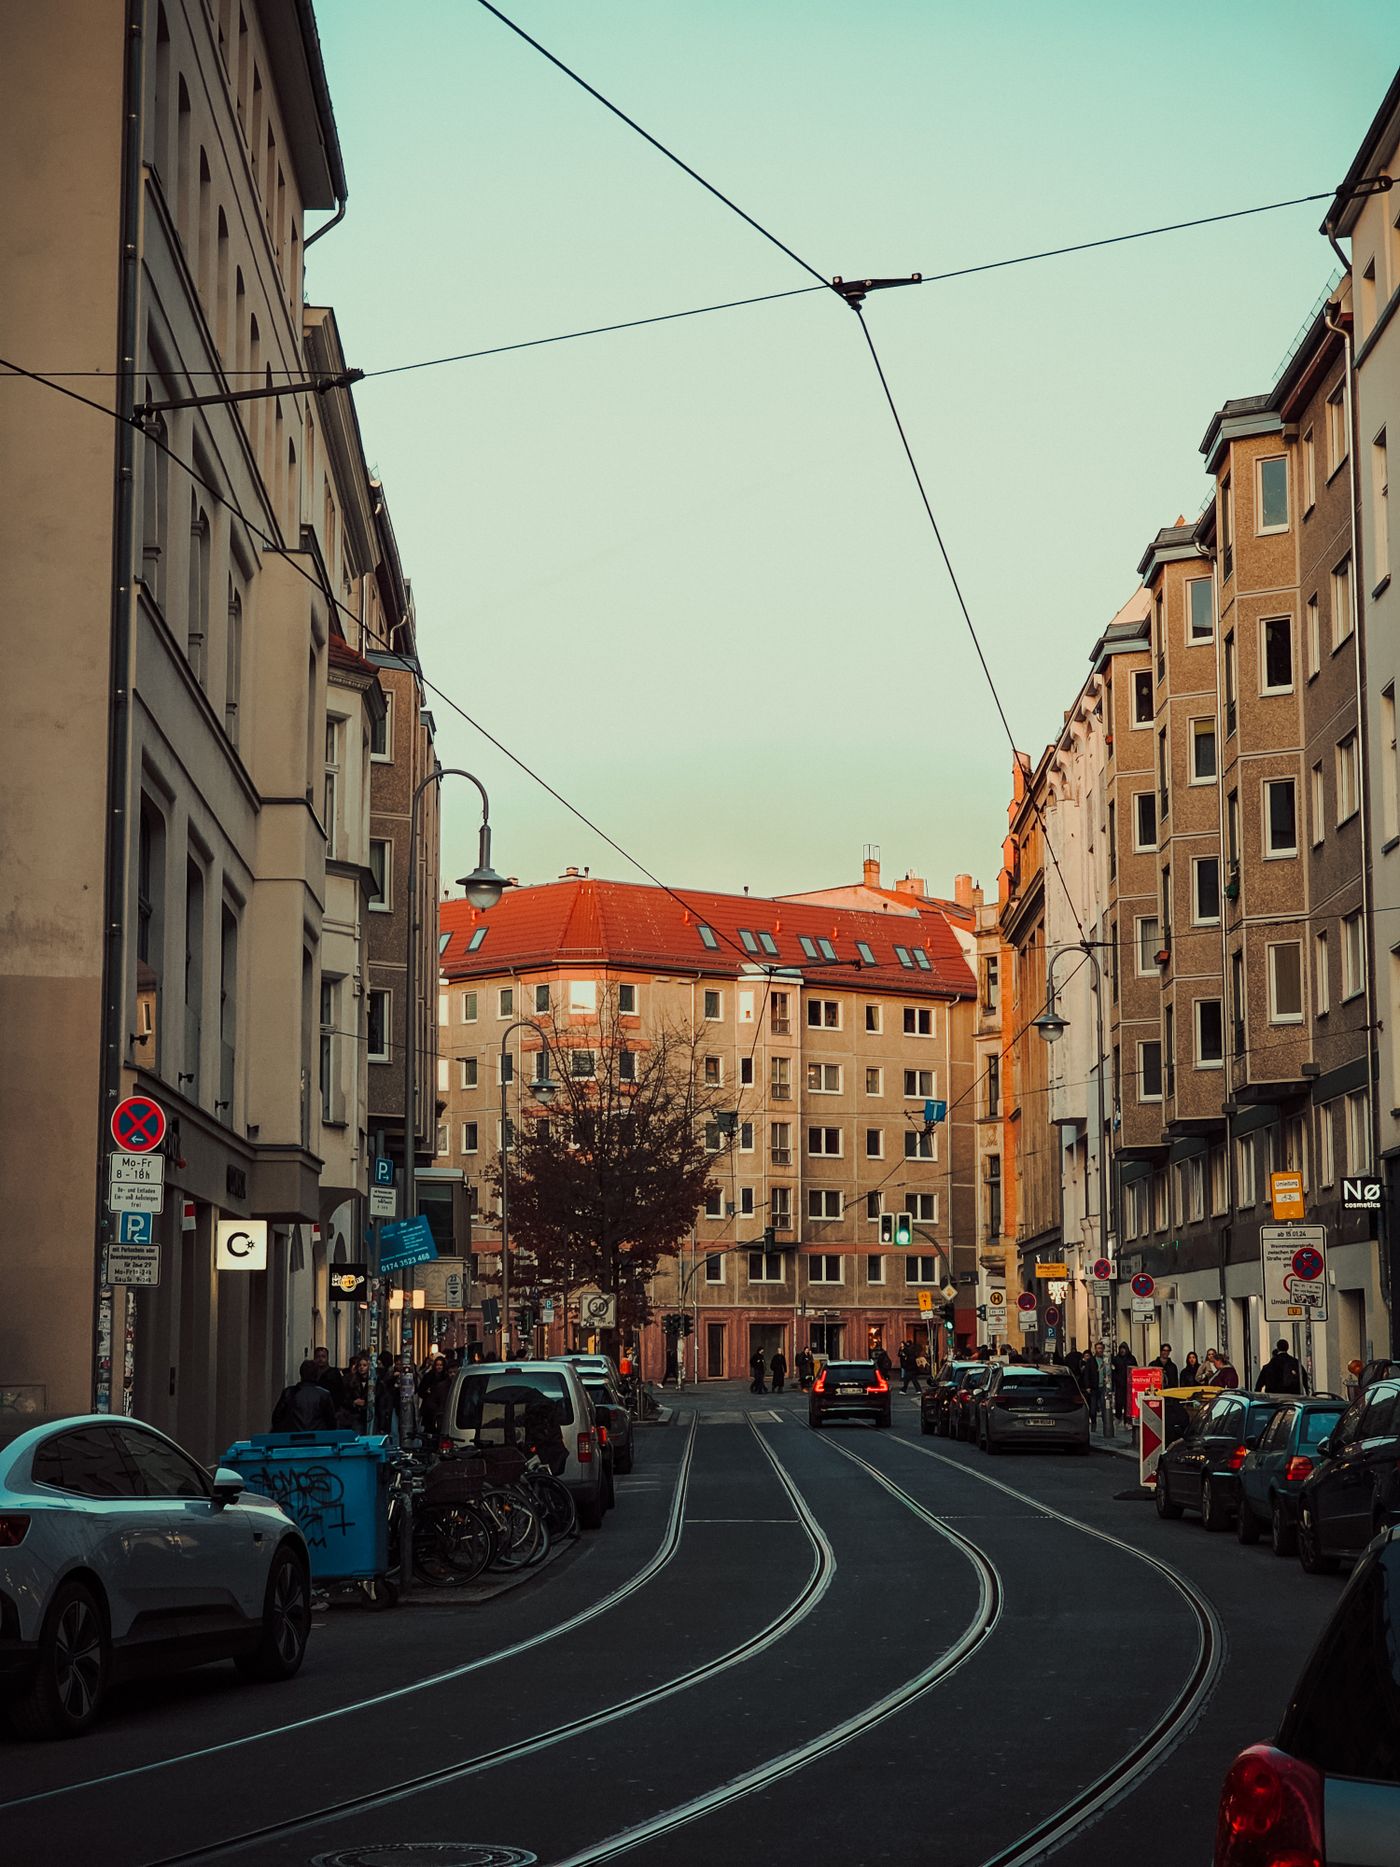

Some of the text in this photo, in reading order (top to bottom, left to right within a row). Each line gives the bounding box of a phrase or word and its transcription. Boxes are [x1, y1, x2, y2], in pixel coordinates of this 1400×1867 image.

[122, 1158, 152, 1168] Mo-Fr
[134, 1169, 150, 1180] 18h
[378, 1162, 388, 1180] P
[1343, 1180, 1380, 1200] Nø
[127, 1215, 145, 1241] P
[381, 1261, 399, 1272] 0174
[399, 1257, 417, 1267] 3523
[592, 1301, 605, 1312] 30
